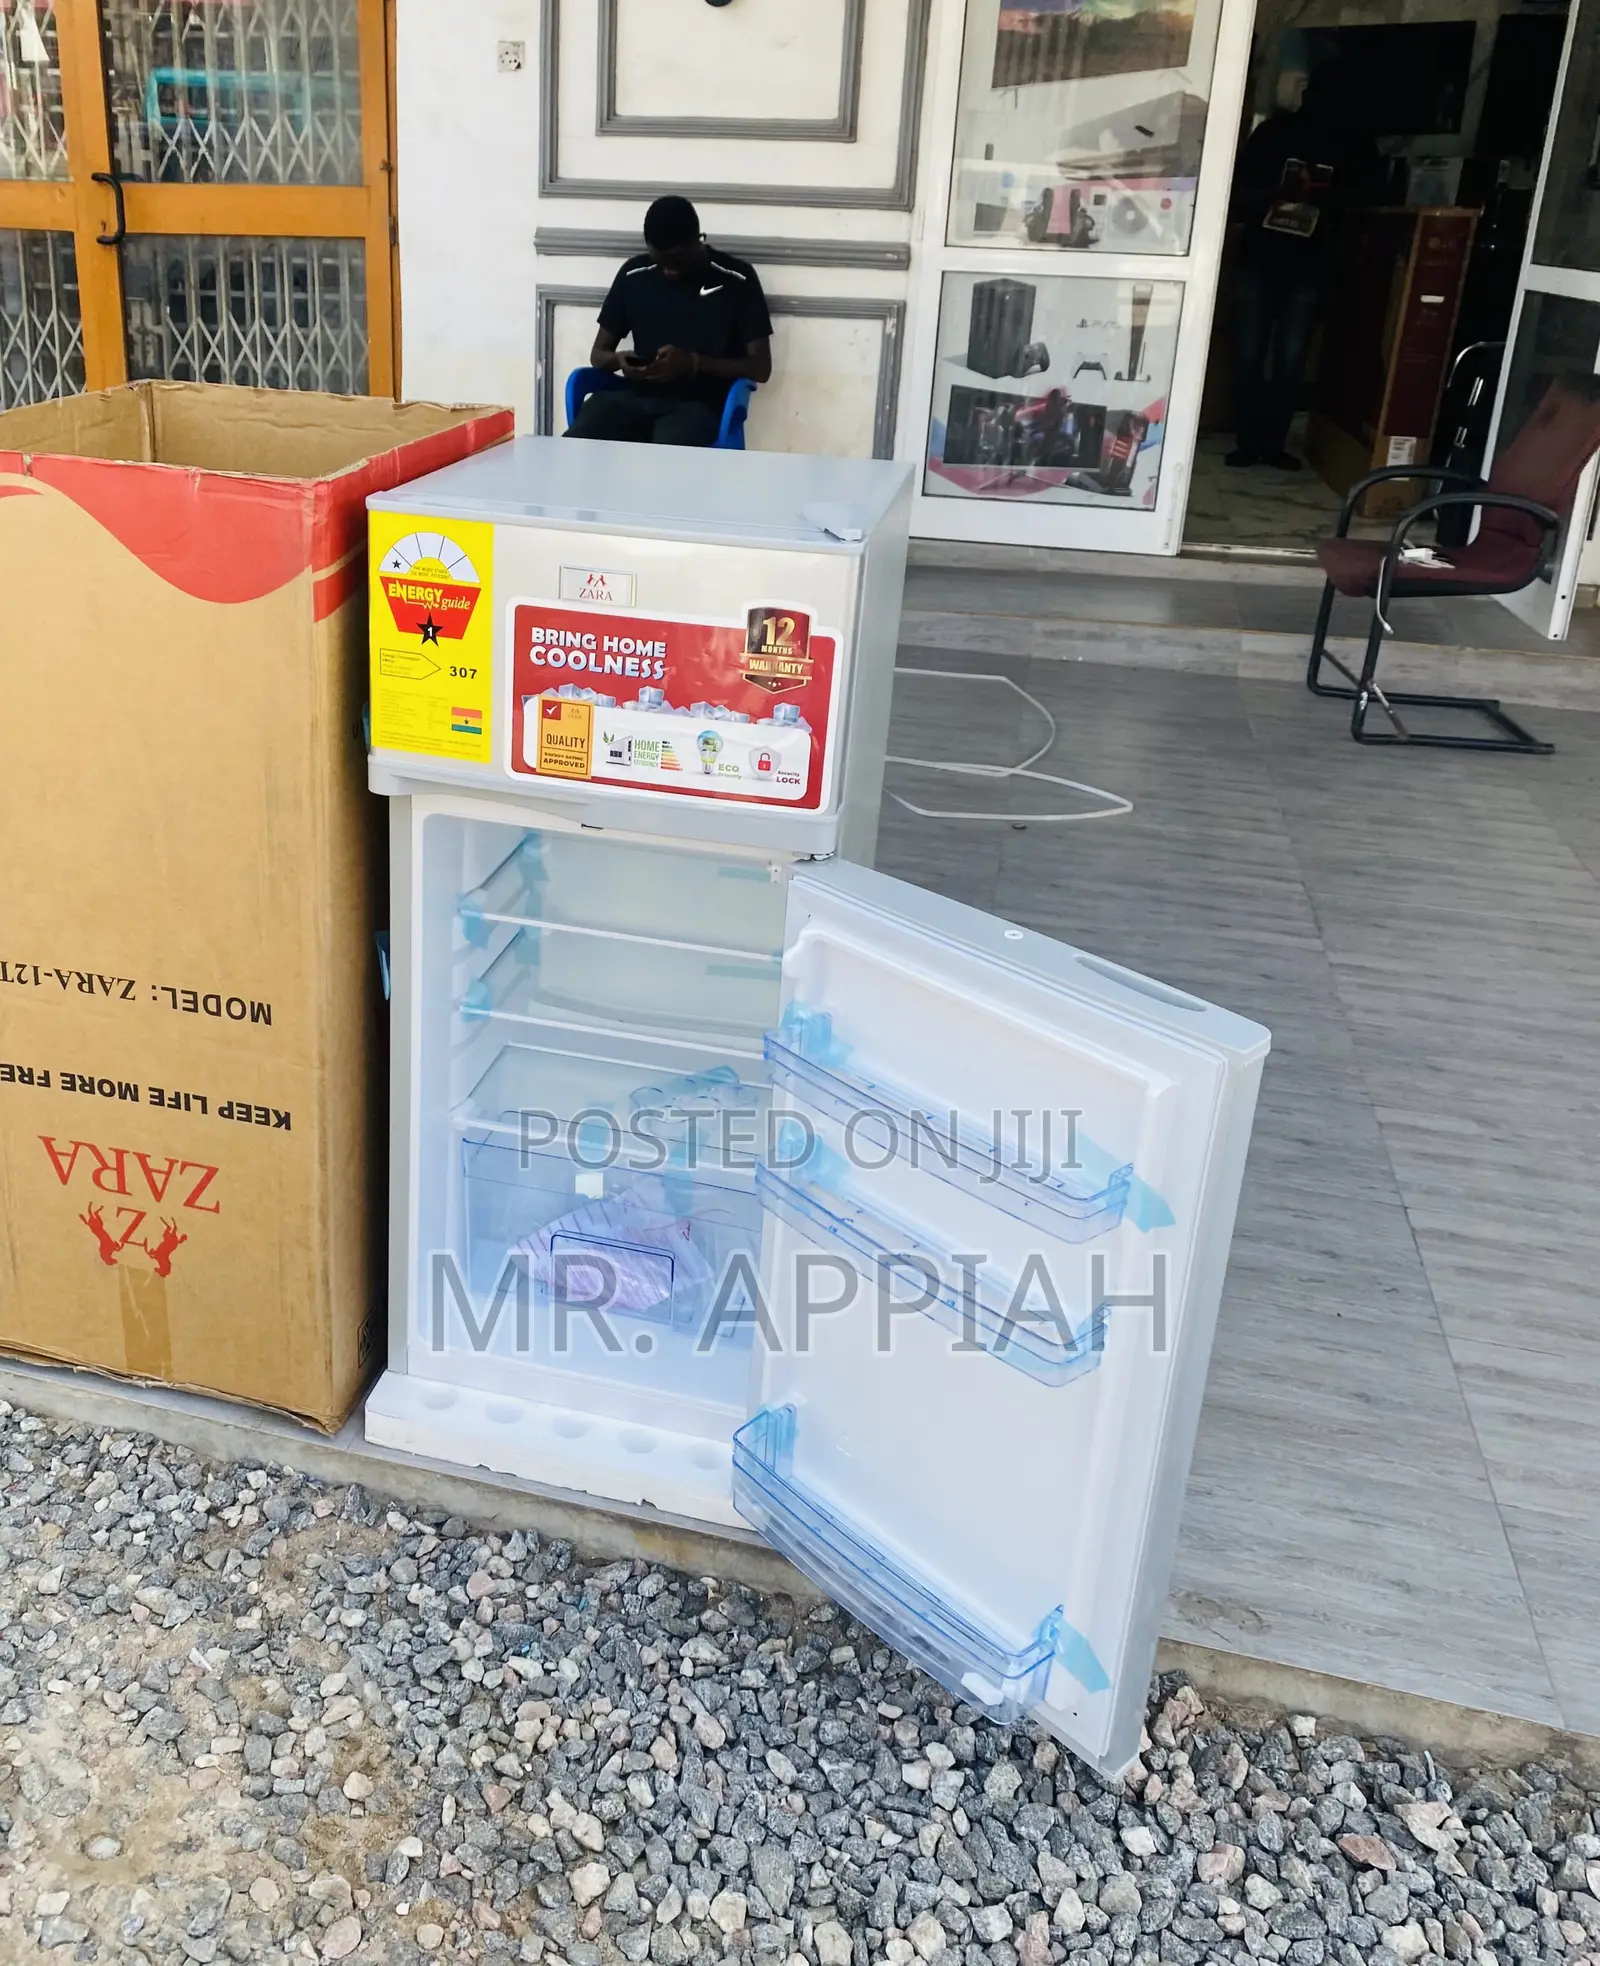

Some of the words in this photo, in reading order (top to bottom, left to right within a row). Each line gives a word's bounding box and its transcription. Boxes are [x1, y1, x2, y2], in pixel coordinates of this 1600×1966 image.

[388, 580, 444, 602] ENERGY
[441, 596, 471, 611] guide
[579, 587, 613, 601] ZARA
[427, 626, 433, 637] 1
[762, 617, 796, 648] 12
[531, 626, 597, 650] BRING
[603, 635, 667, 658] HOME
[761, 645, 793, 655] MONTHS
[529, 645, 665, 681] COOLNESS
[749, 659, 804, 674] WARRANTY
[449, 665, 478, 679] 307
[546, 733, 586, 749] QUALITY
[634, 739, 660, 752] HOME
[634, 750, 660, 761] ENERGY
[543, 758, 586, 769] APPROVED
[718, 763, 740, 772] ECO
[776, 776, 801, 784] LOCK
[151, 984, 272, 1026] MODEL:
[60, 1072, 139, 1102] MORE
[149, 1086, 207, 1115] LIFE
[218, 1100, 292, 1130] KEEP
[37, 1135, 220, 1214] ZARA
